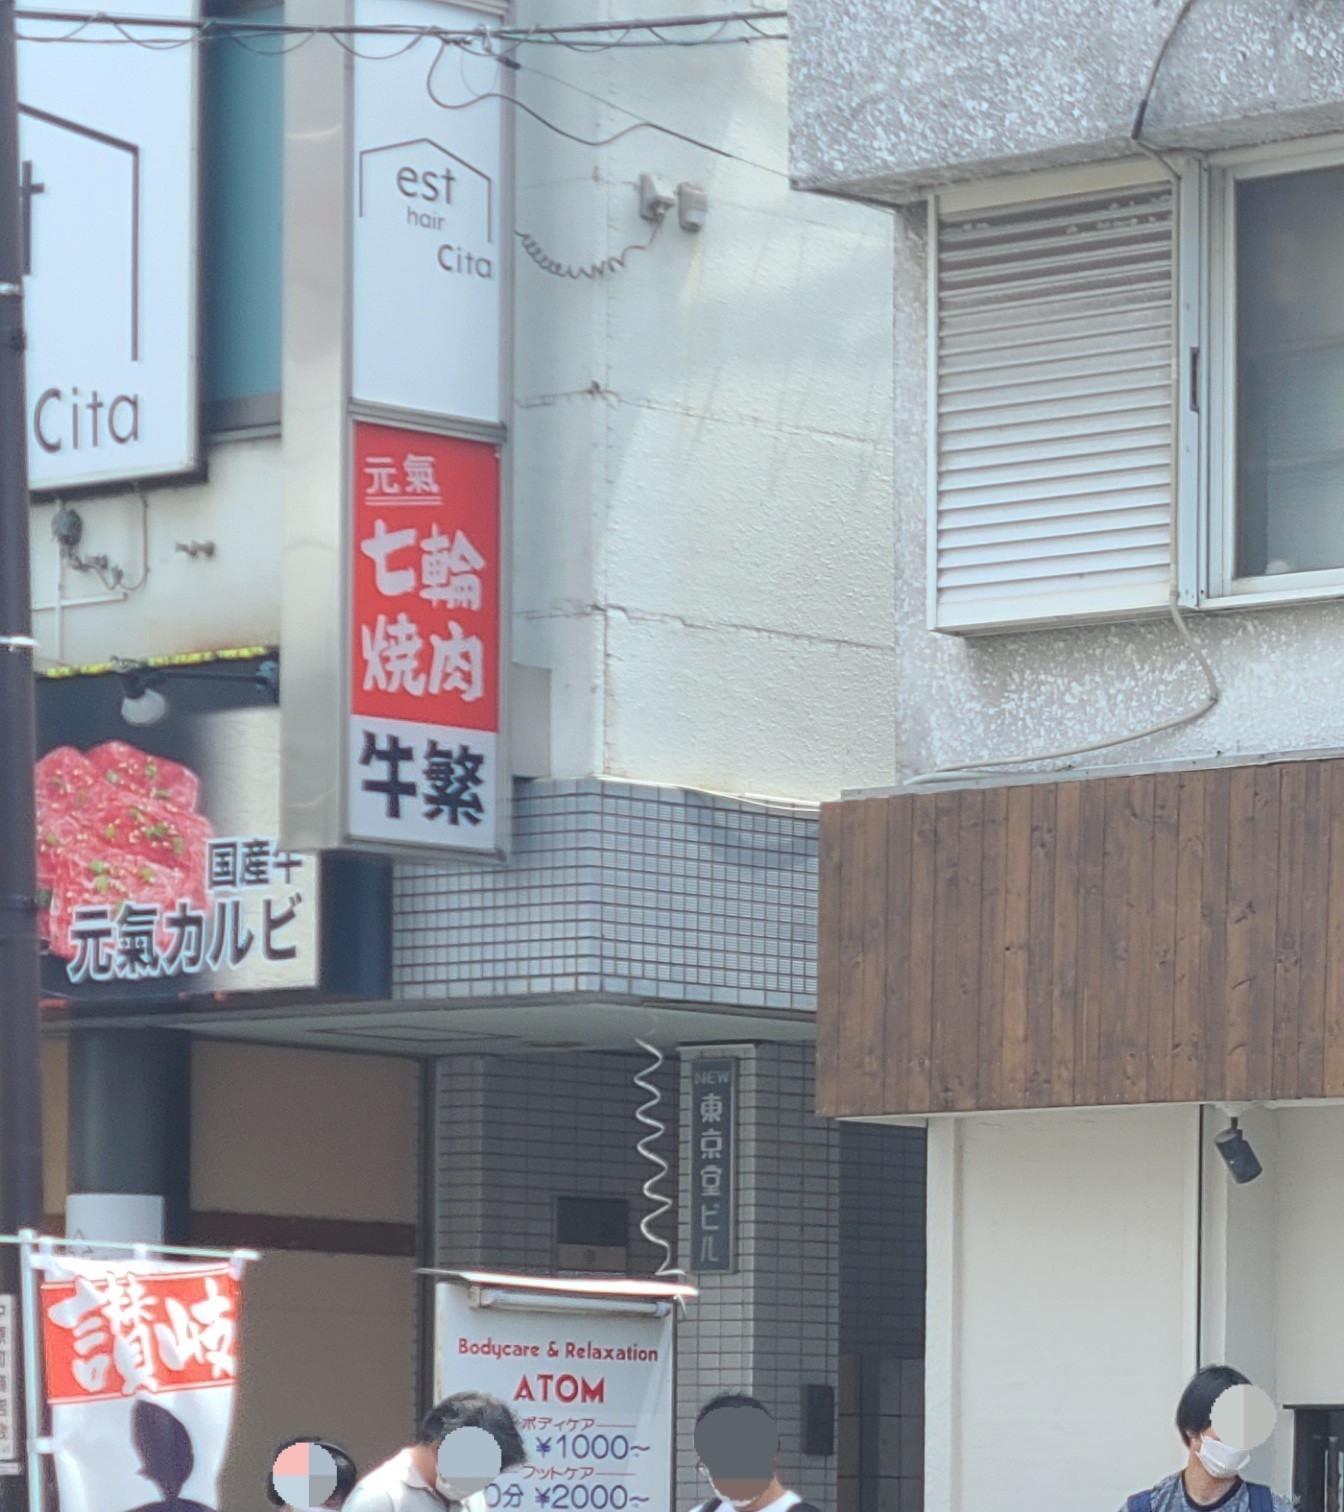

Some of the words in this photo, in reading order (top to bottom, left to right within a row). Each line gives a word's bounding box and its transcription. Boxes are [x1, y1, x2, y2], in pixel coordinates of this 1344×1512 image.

[396, 165, 456, 205] est
[407, 208, 446, 232] hair
[437, 244, 493, 280] Cita
[33, 388, 141, 455] Cita
[363, 454, 439, 494] 元氣
[360, 518, 486, 612] 七輪
[360, 612, 486, 702] 焼肉
[358, 729, 486, 828] 牛繁
[66, 891, 304, 983] 元氣カルビ
[695, 1070, 730, 1085] NEW
[701, 1091, 723, 1263] 東京堂ビル
[458, 1338, 540, 1360] Bodycare
[548, 1342, 560, 1358] &
[565, 1341, 659, 1362] Relaxation
[513, 1374, 606, 1404] ATOM
[522, 1417, 596, 1432] ボディケア
[522, 1465, 594, 1480] フットケア
